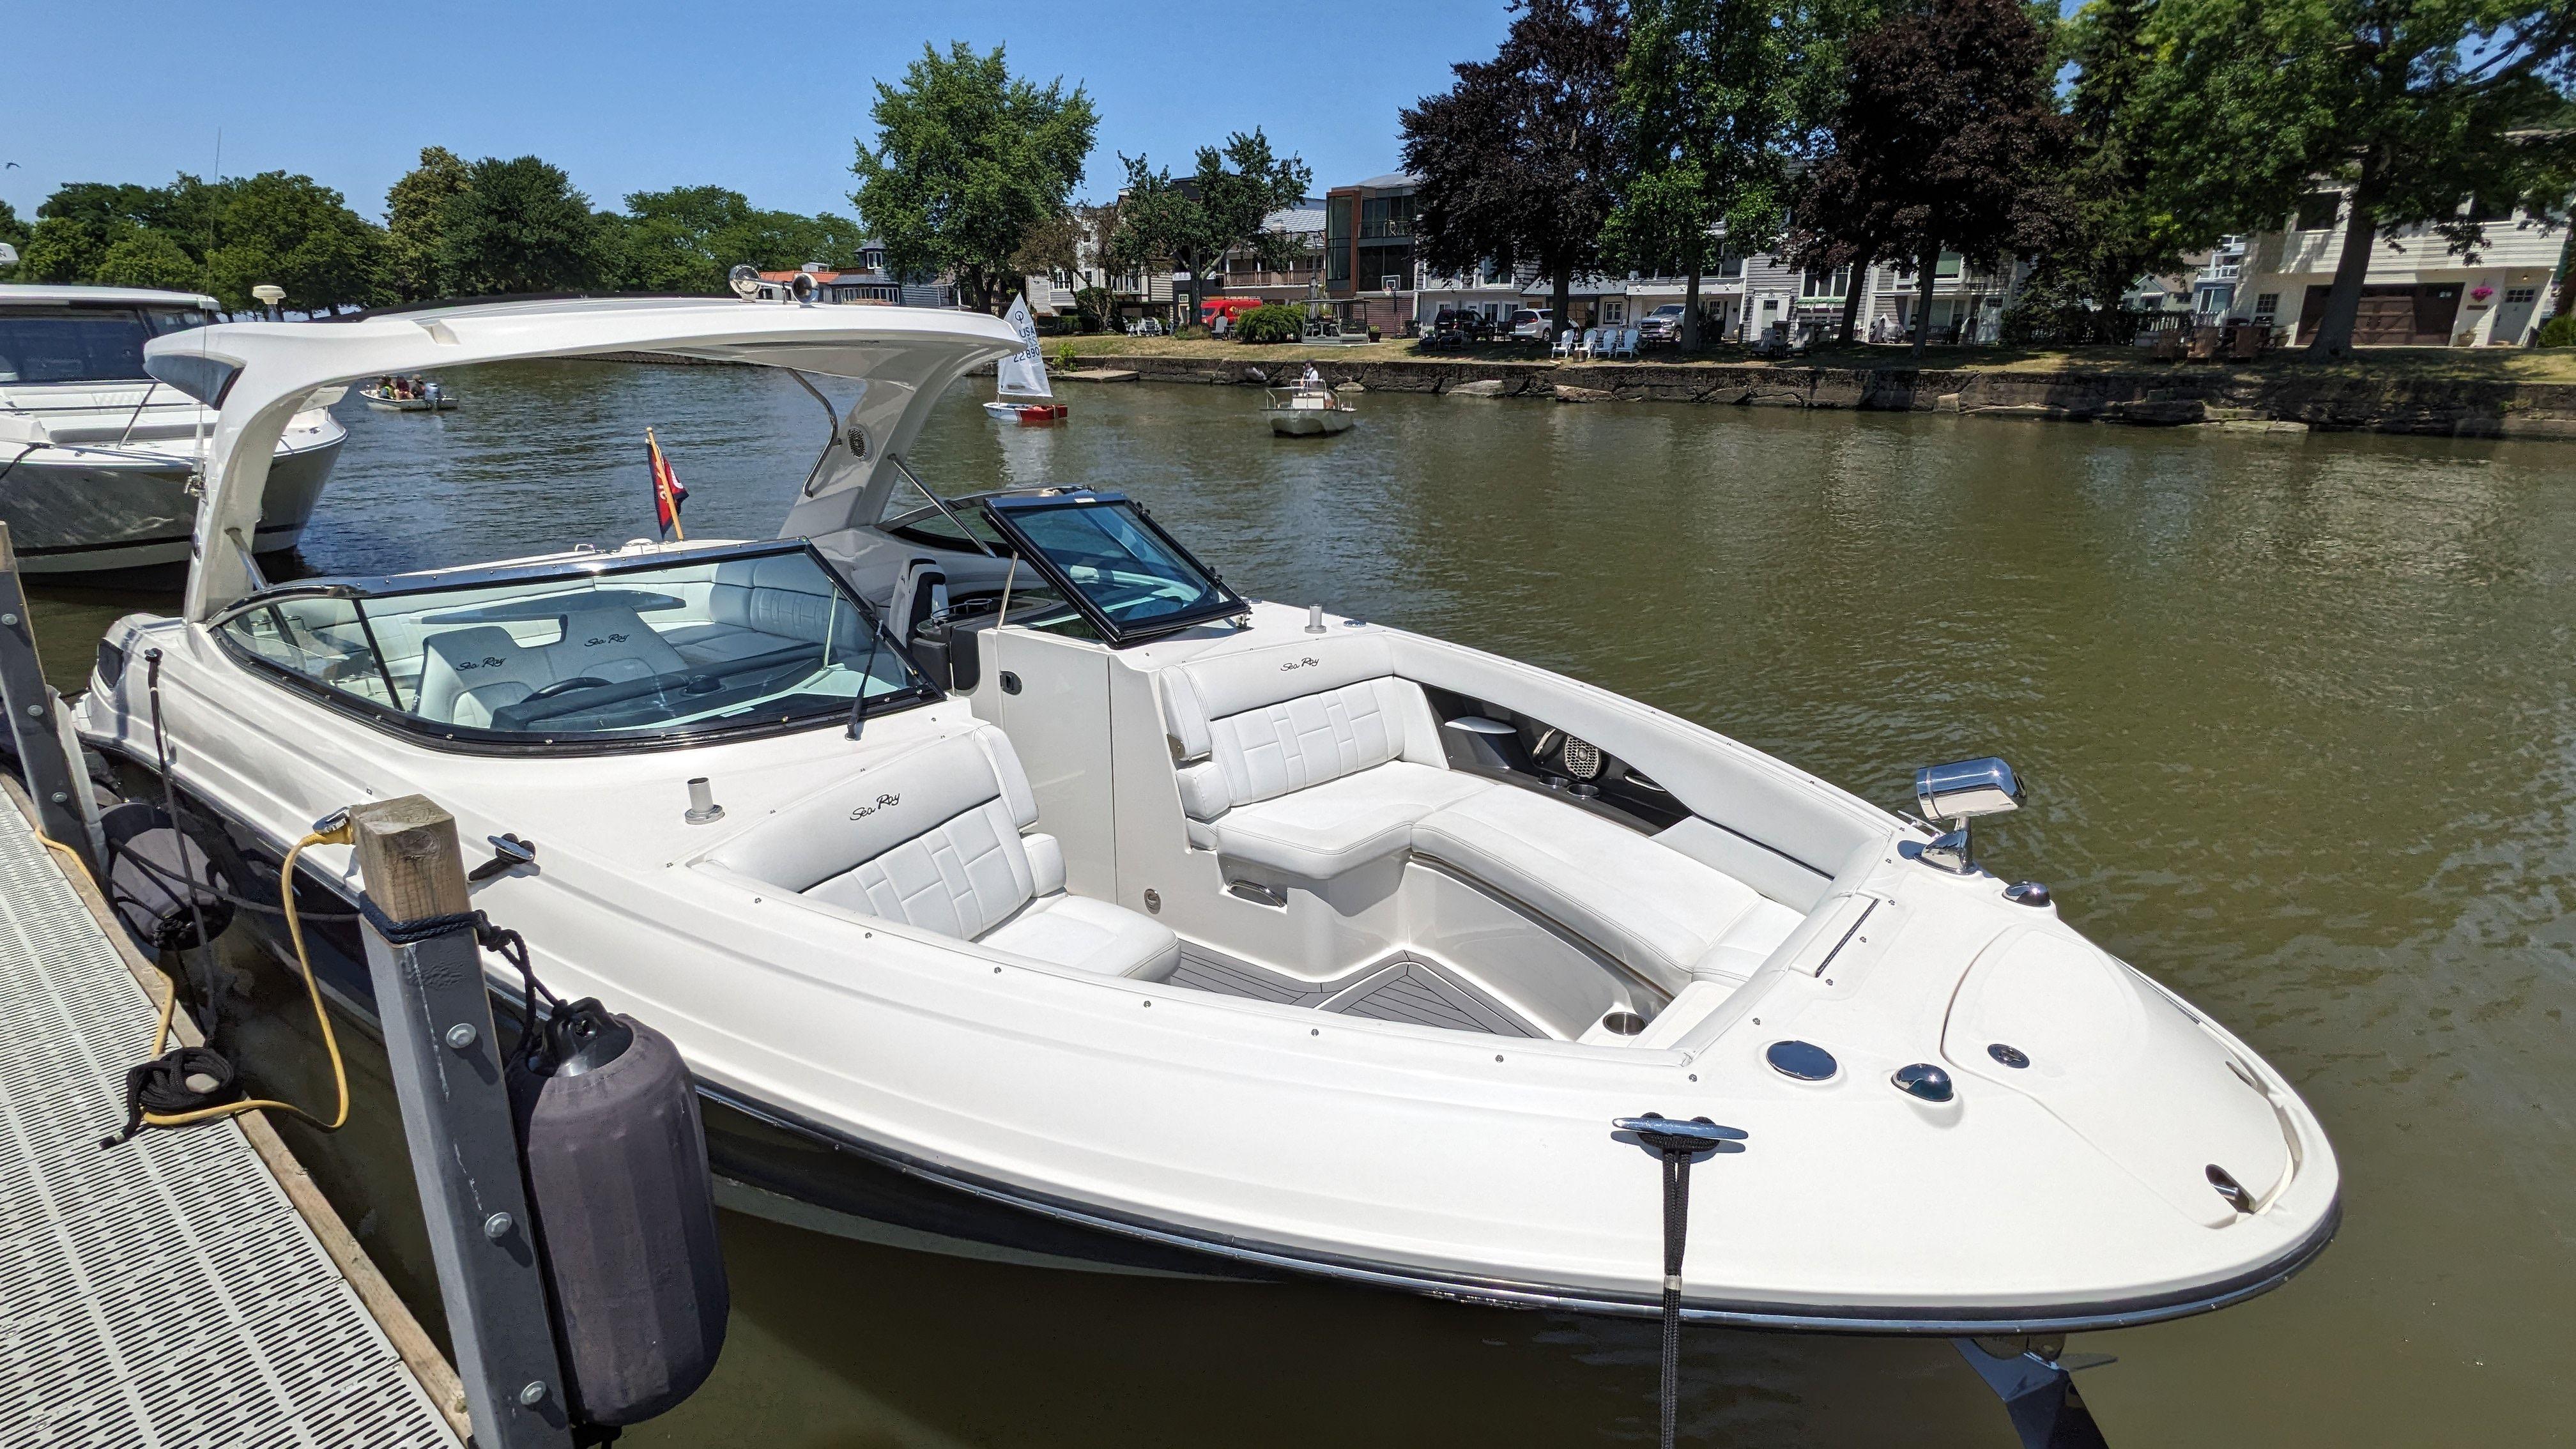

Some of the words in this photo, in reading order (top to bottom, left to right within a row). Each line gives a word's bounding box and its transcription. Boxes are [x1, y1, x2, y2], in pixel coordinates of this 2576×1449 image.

[1019, 326, 1035, 338] USA
[1013, 347, 1040, 363] 22890
[584, 638, 606, 647] Sea
[608, 633, 630, 644] Ray
[456, 662, 479, 671] Sea
[482, 657, 506, 668] Ray
[1280, 663, 1300, 671] Sea
[1301, 657, 1319, 666] Ray
[850, 807, 876, 820] Sea
[876, 793, 900, 809] Ray
